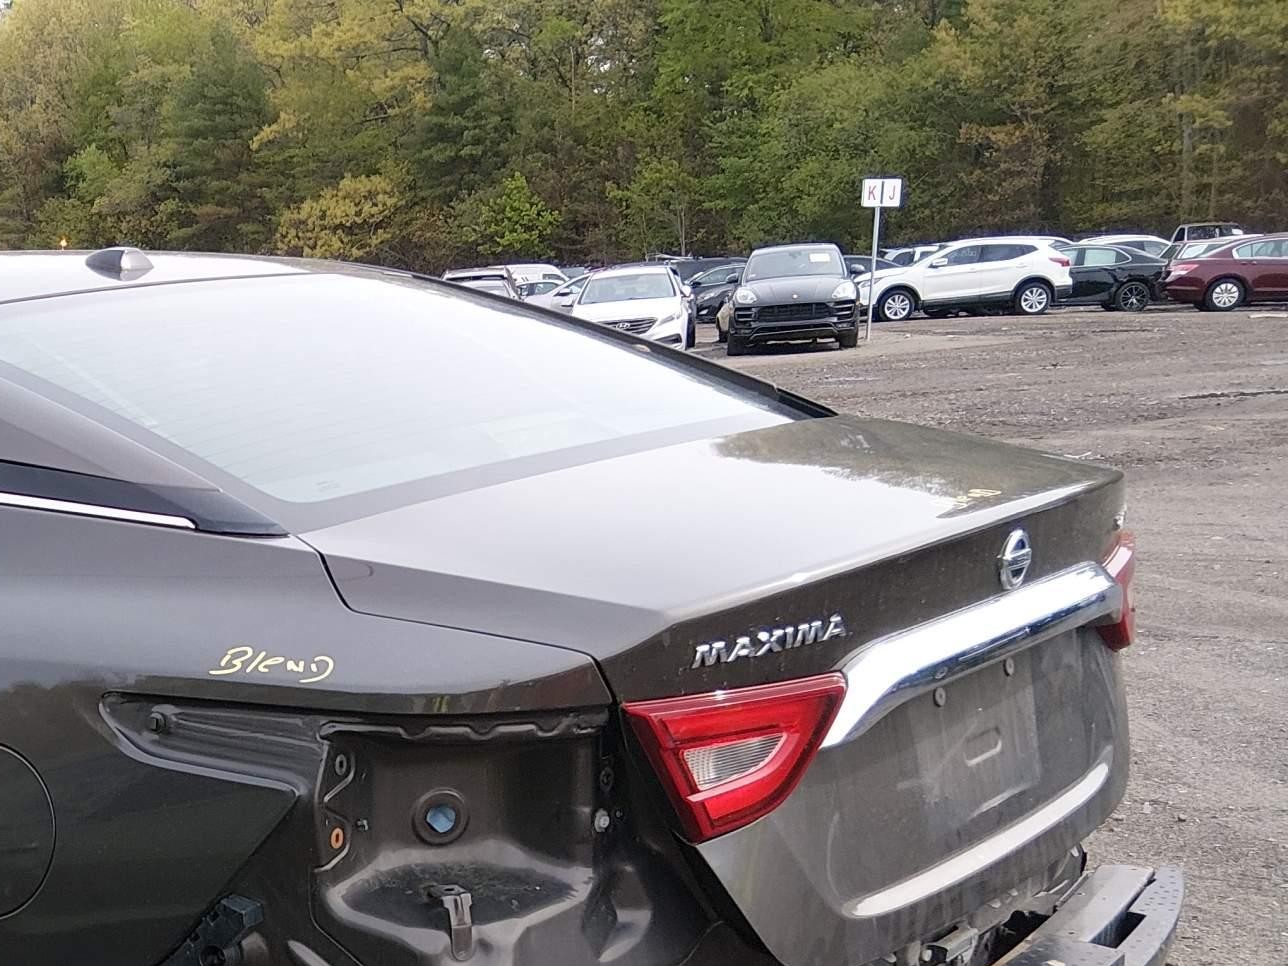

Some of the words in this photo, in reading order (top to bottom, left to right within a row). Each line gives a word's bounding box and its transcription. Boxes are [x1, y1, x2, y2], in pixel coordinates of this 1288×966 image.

[868, 185, 877, 201] K
[888, 185, 897, 201] J
[691, 613, 847, 669] MAXIMA
